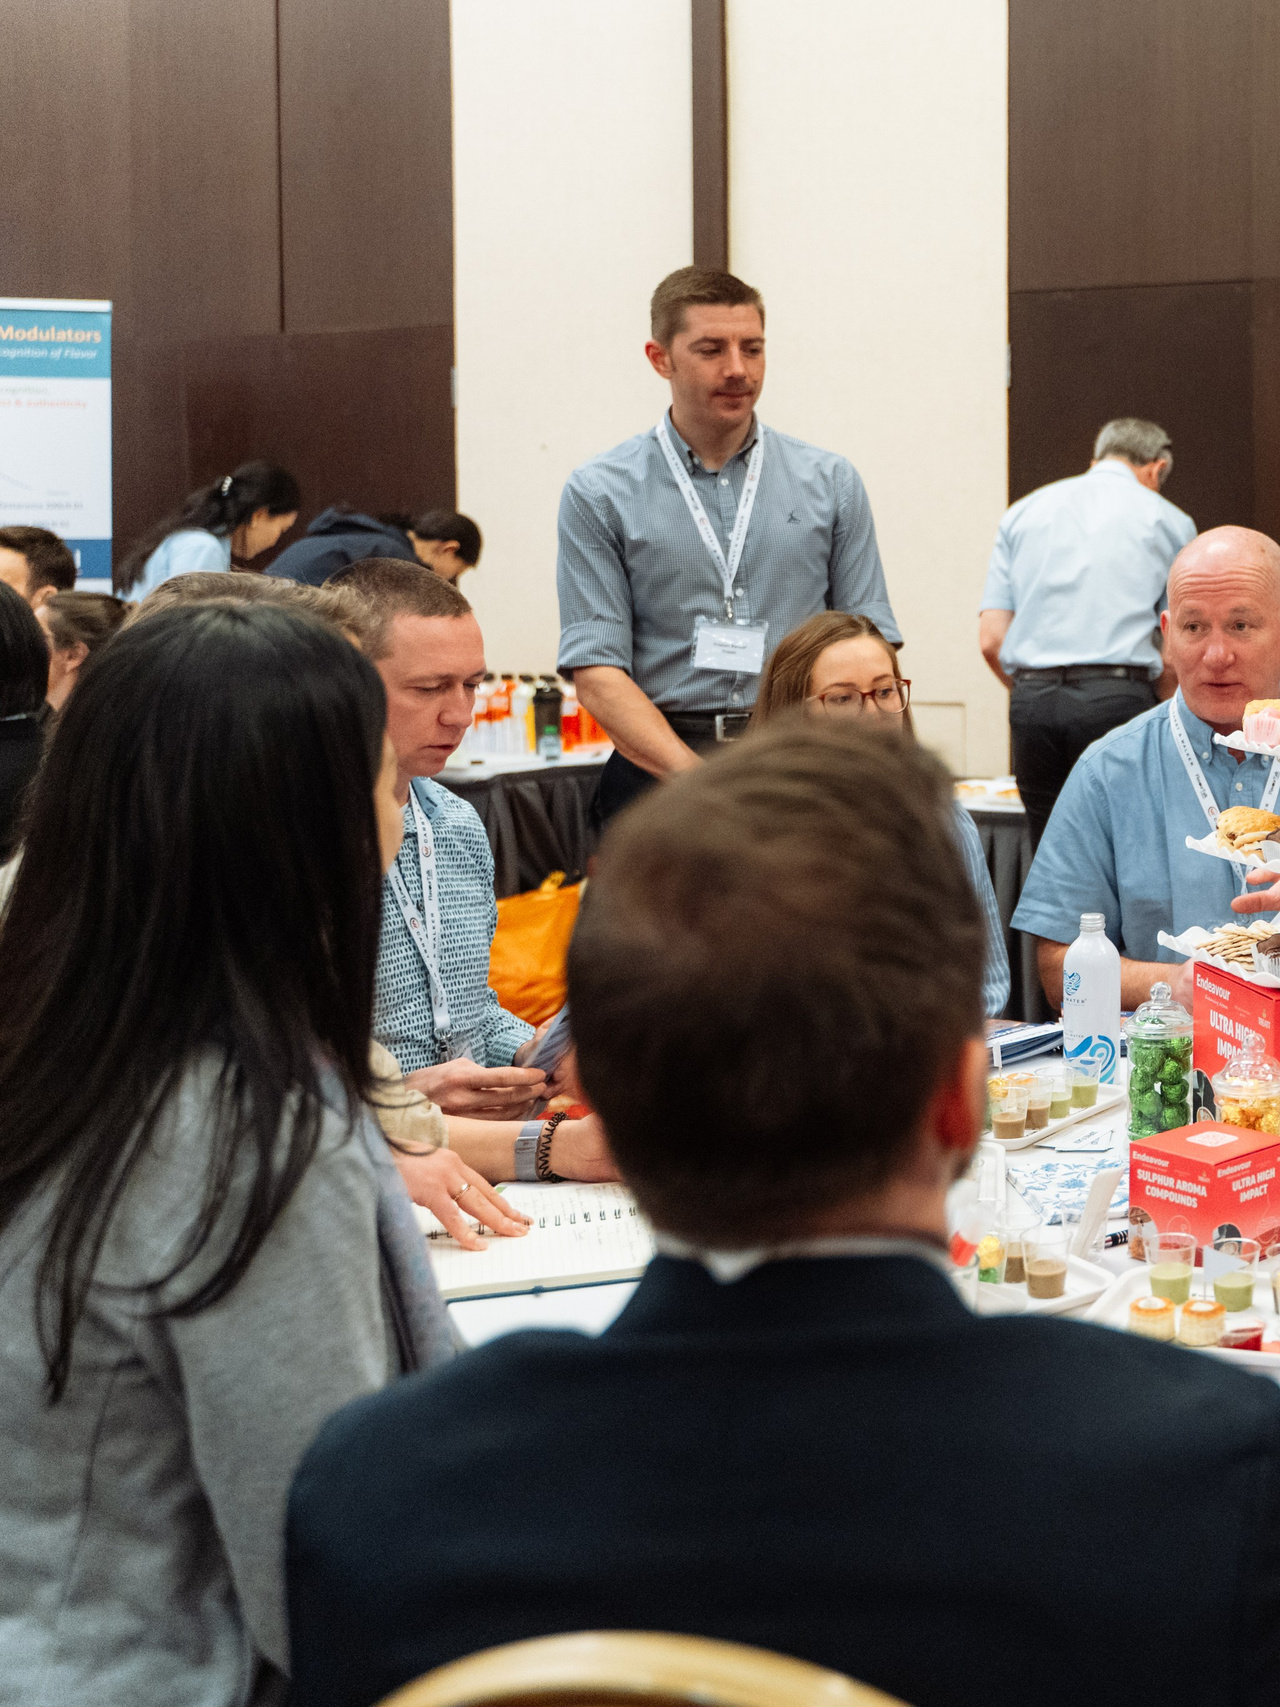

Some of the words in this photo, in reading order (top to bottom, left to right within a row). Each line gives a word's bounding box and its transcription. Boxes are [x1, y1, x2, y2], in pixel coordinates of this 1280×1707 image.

[0, 325, 101, 343] Modulators
[1196, 973, 1231, 1001] Endeavour
[1210, 1009, 1234, 1038] ULTRA
[1132, 1150, 1170, 1168] Endeavour
[1217, 1160, 1252, 1178] Endeavour
[1137, 1168, 1175, 1189] SULPHUR
[1176, 1179, 1208, 1197] AROMA
[1232, 1174, 1257, 1192] ULTRA
[1257, 1167, 1275, 1183] HIGH
[1145, 1185, 1198, 1208] COMPOUNDS
[1240, 1183, 1268, 1203] IMPACT
